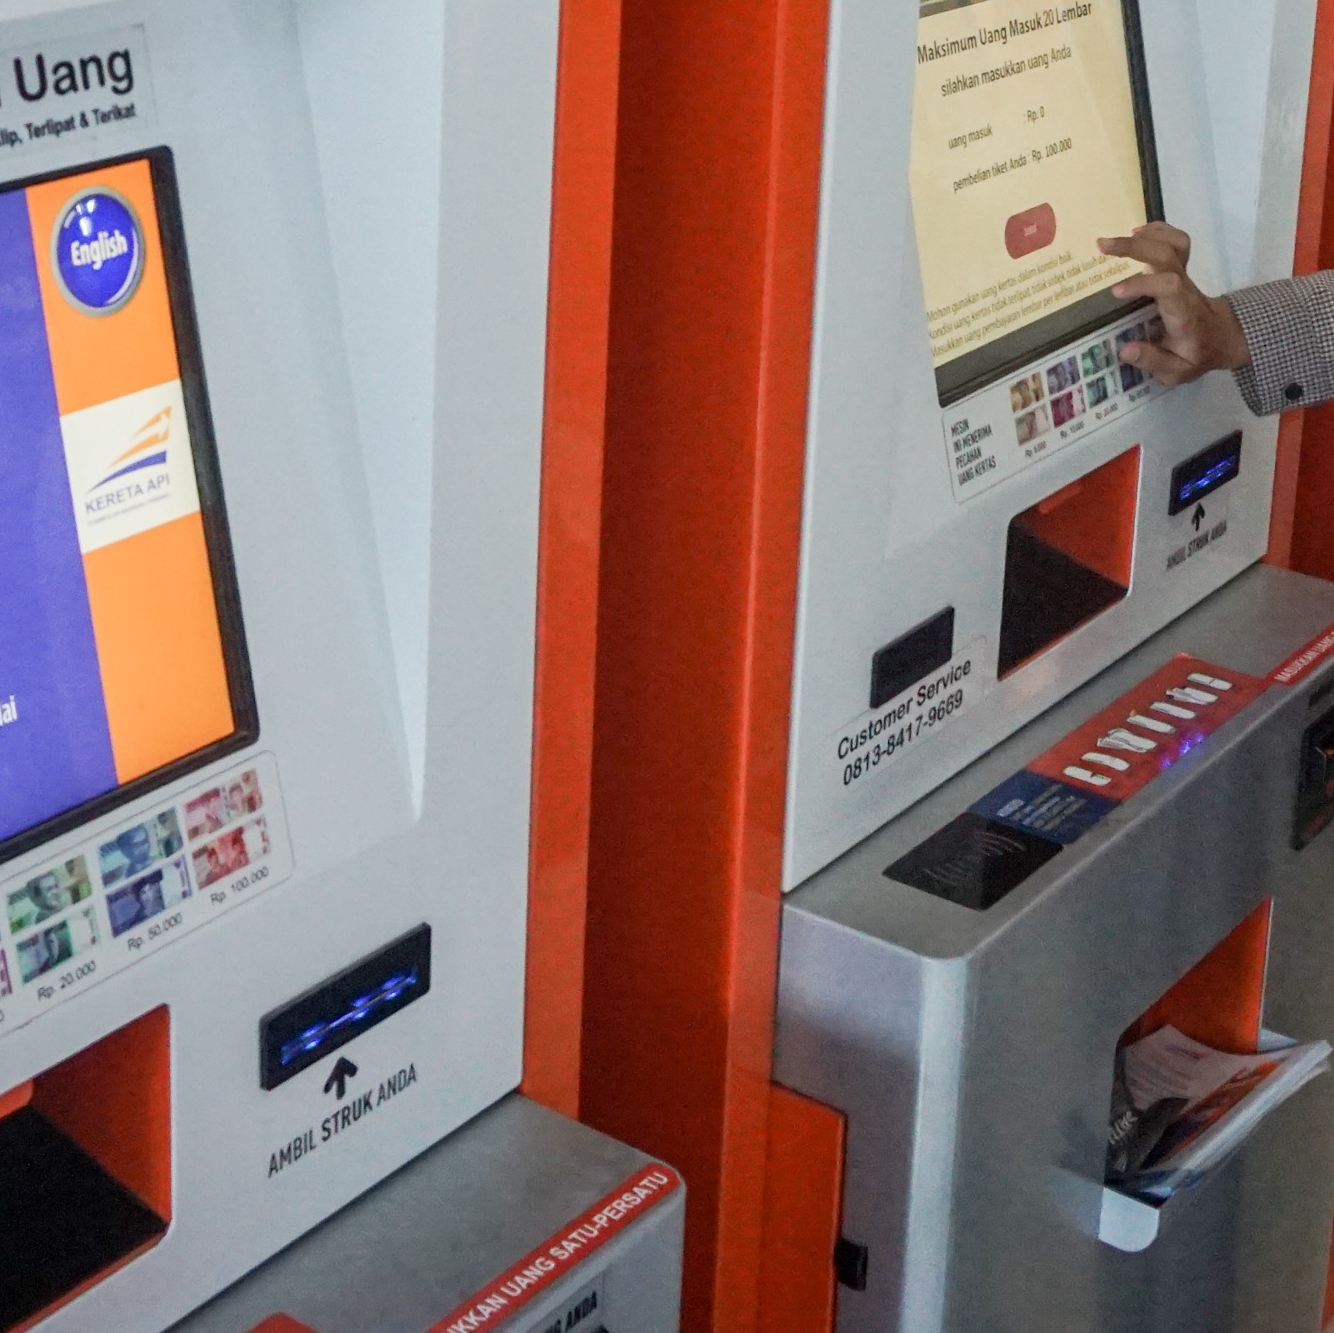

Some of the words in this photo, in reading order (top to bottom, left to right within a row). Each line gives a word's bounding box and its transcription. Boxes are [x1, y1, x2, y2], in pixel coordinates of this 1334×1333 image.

[917, 32, 978, 65] Maksimum
[979, 24, 1008, 47] Uang
[1009, 12, 1043, 38] Masuk
[1043, 9, 1054, 27] 20
[1055, 1, 1092, 24] Lembar
[13, 47, 135, 102] Uang
[941, 71, 979, 97] silahkan
[981, 59, 1026, 84] masukkan
[1027, 52, 1049, 70] uang
[1050, 44, 1072, 63] Anda
[25, 116, 76, 141] Terlipat
[80, 112, 89, 127] &
[948, 133, 968, 149] uang
[968, 123, 993, 144] masuk
[953, 168, 992, 194] pembelian
[992, 161, 1009, 179] tiket
[1009, 153, 1028, 170] Anda
[70, 230, 128, 270] English
[85, 483, 144, 514] KERETA
[147, 473, 170, 493] API
[837, 698, 914, 760] Customer
[915, 658, 972, 710] Service
[842, 688, 965, 786] 0813-8417-9669
[267, 1129, 317, 1179] AMBIL
[320, 1089, 374, 1143] STRUK
[376, 1062, 418, 1107] ANDA
[500, 1256, 556, 1298] UANG
[549, 1171, 669, 1260] SATU-PERSATU
